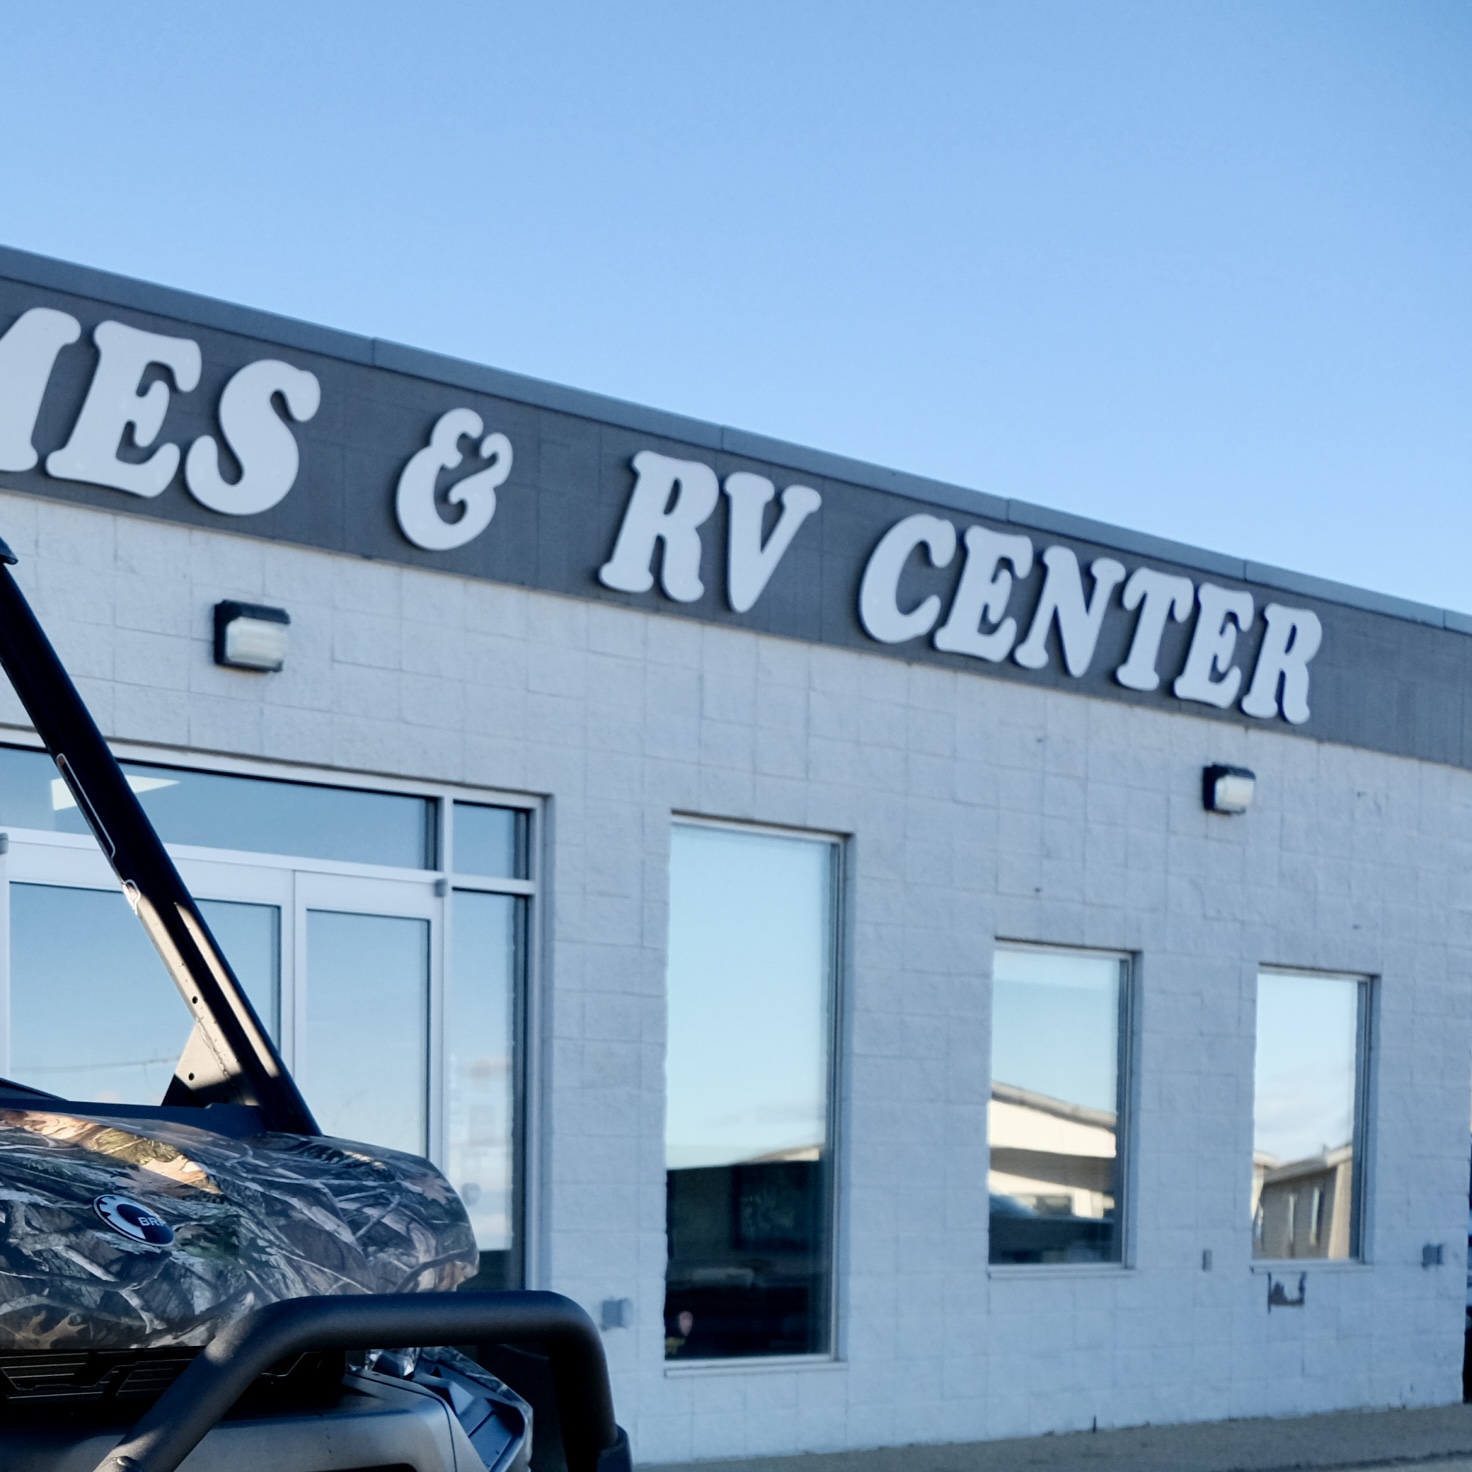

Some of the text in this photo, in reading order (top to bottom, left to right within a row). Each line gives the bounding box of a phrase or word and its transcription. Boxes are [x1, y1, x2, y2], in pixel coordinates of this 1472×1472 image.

[397, 407, 514, 552] &
[599, 448, 823, 614] RV
[859, 512, 1324, 725] CENTER
